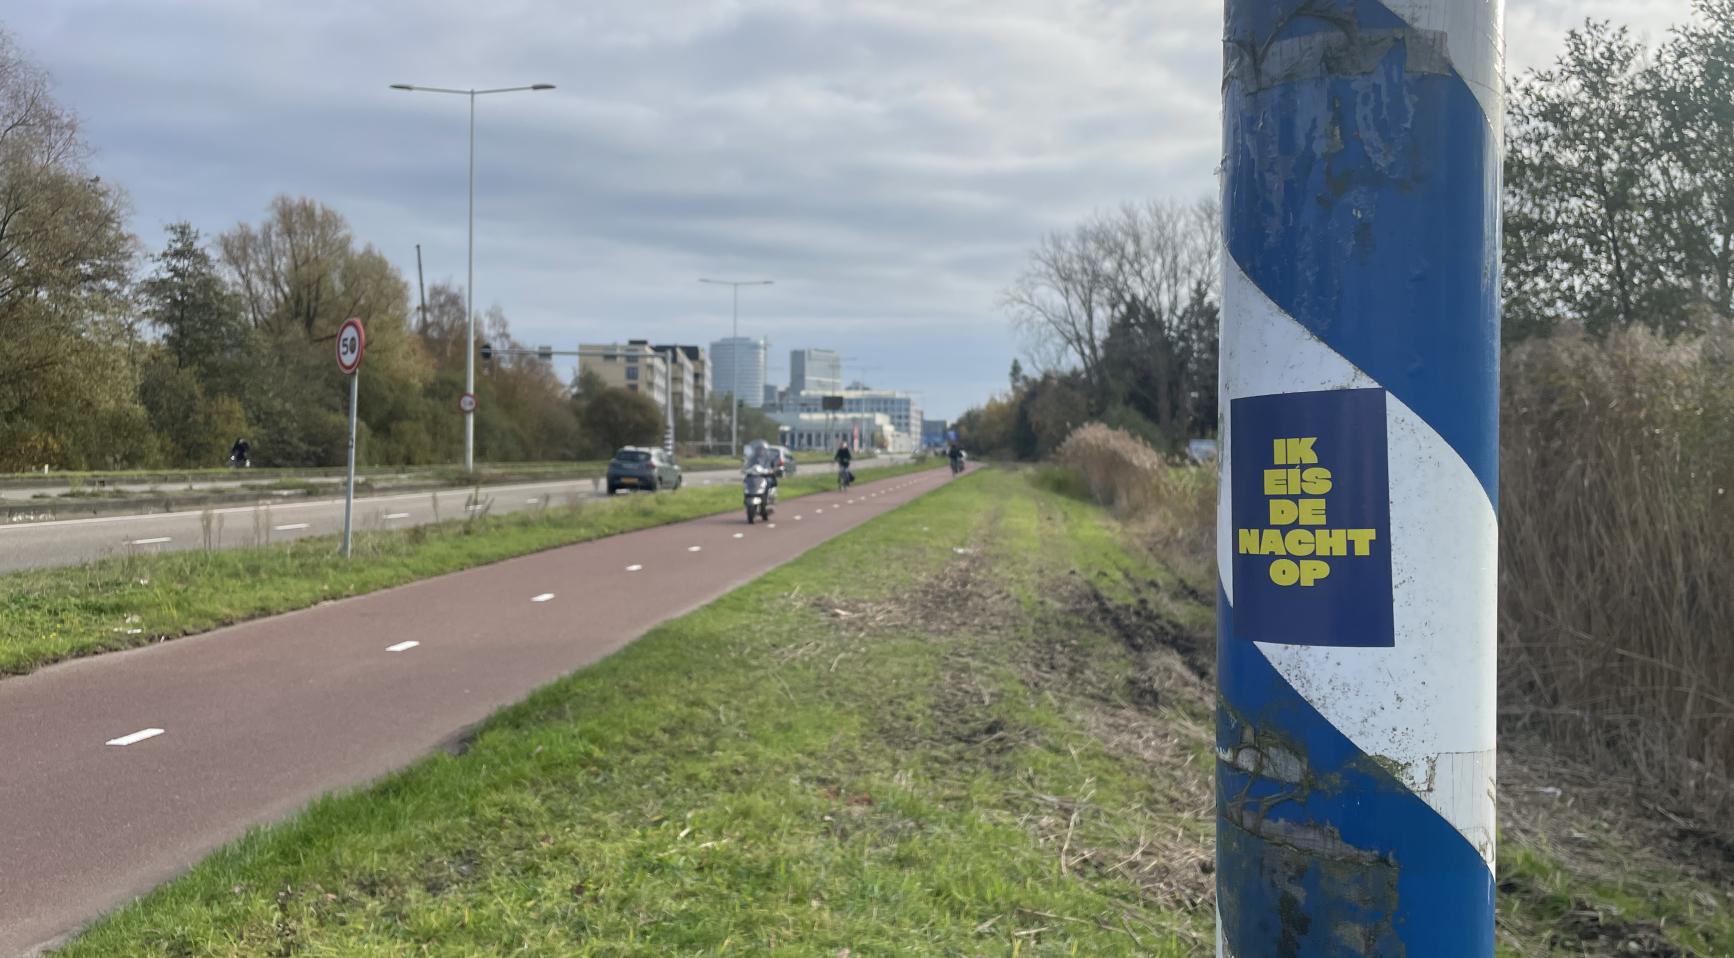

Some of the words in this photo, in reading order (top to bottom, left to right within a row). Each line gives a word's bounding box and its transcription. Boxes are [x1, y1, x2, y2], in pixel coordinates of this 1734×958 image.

[342, 337, 356, 355] 50
[1273, 437, 1318, 465] IK
[1269, 499, 1327, 525] DE
[1238, 529, 1376, 556] NACHT
[1269, 558, 1330, 587] OP
